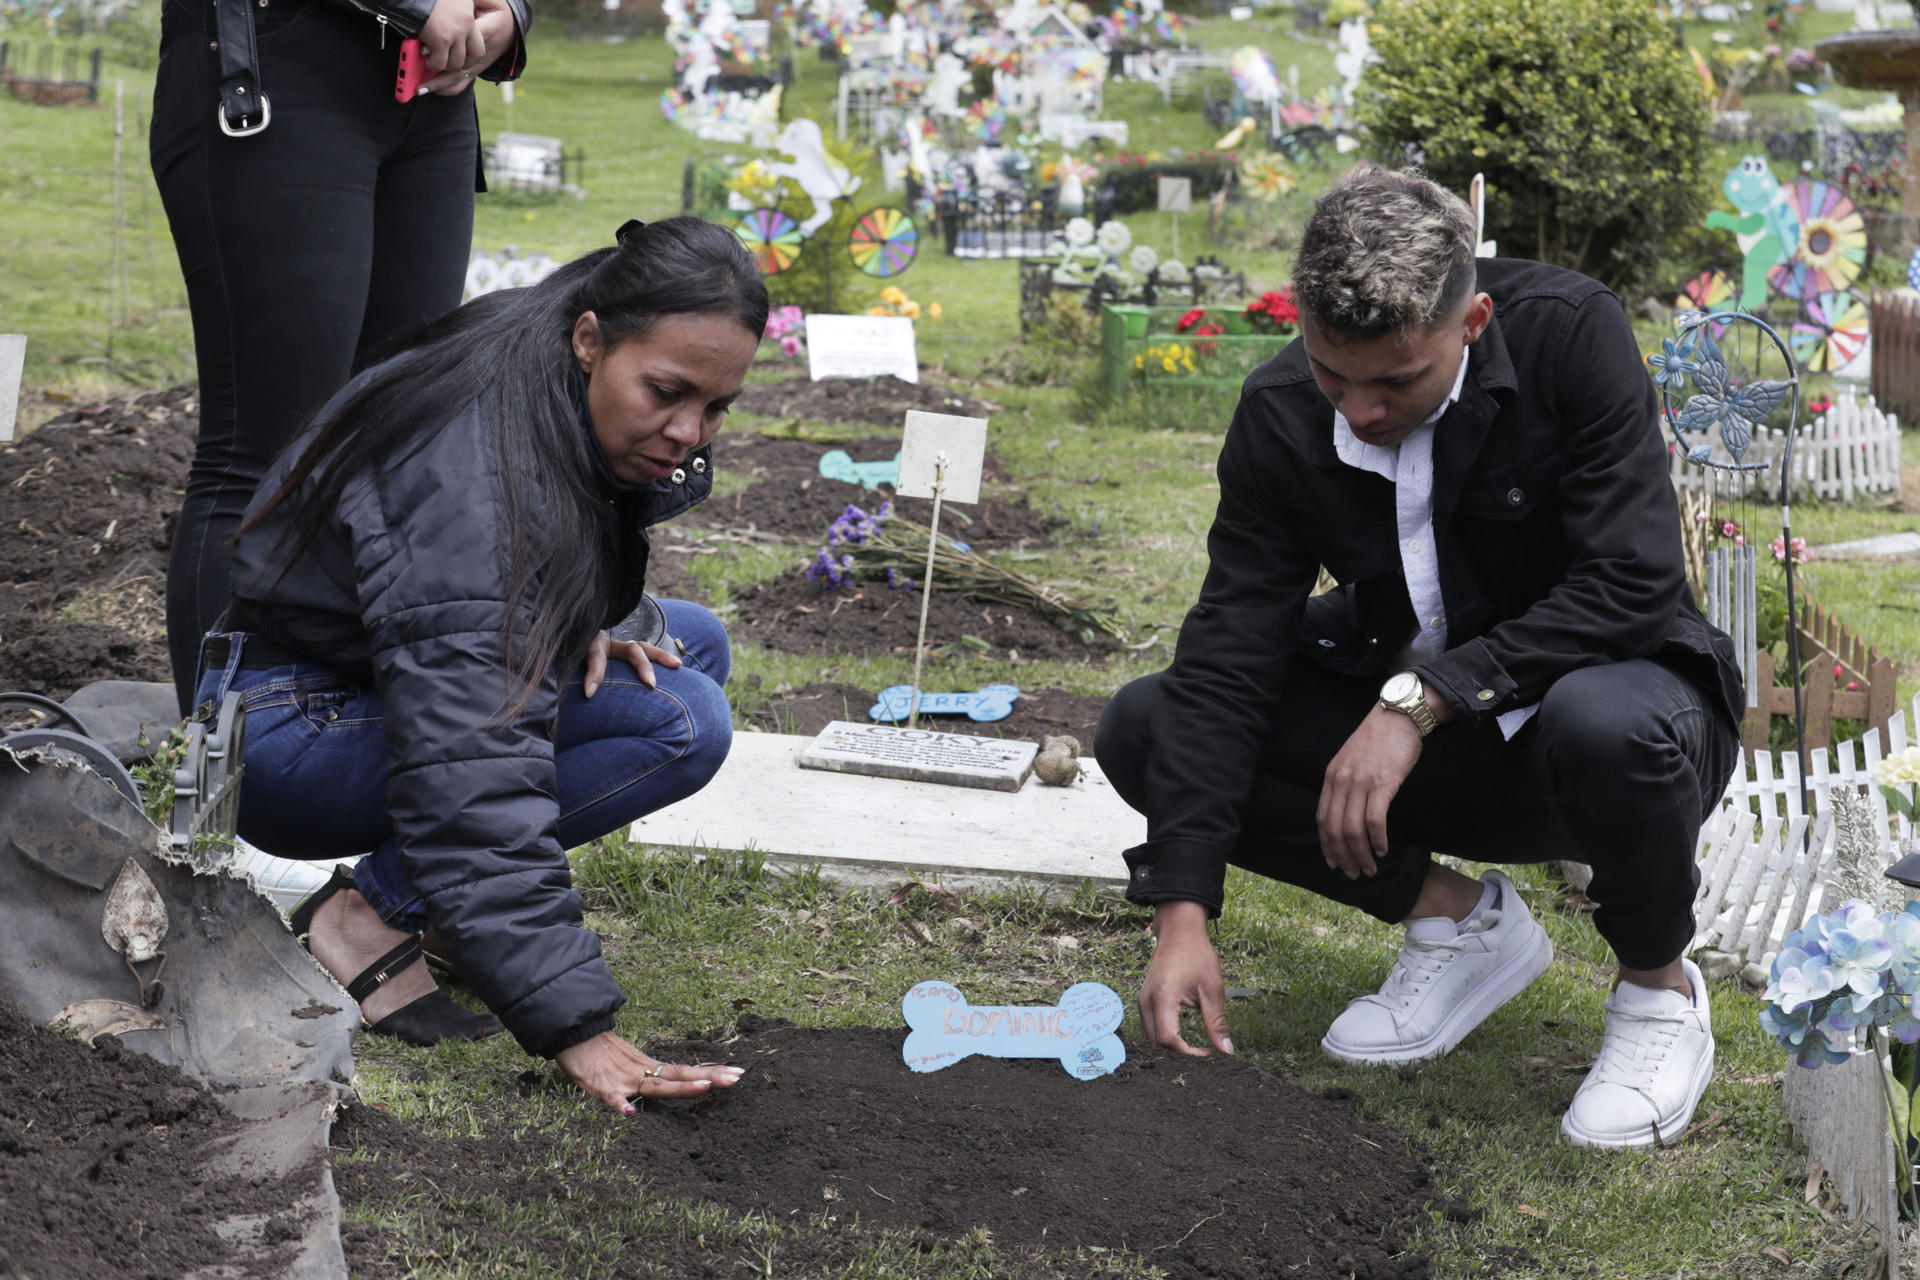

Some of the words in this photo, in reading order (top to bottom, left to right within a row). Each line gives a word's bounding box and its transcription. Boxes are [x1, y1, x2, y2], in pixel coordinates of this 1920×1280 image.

[894, 696, 990, 708] JERRY
[866, 727, 998, 746] COKY
[944, 1008, 1074, 1039] DOMINIC
